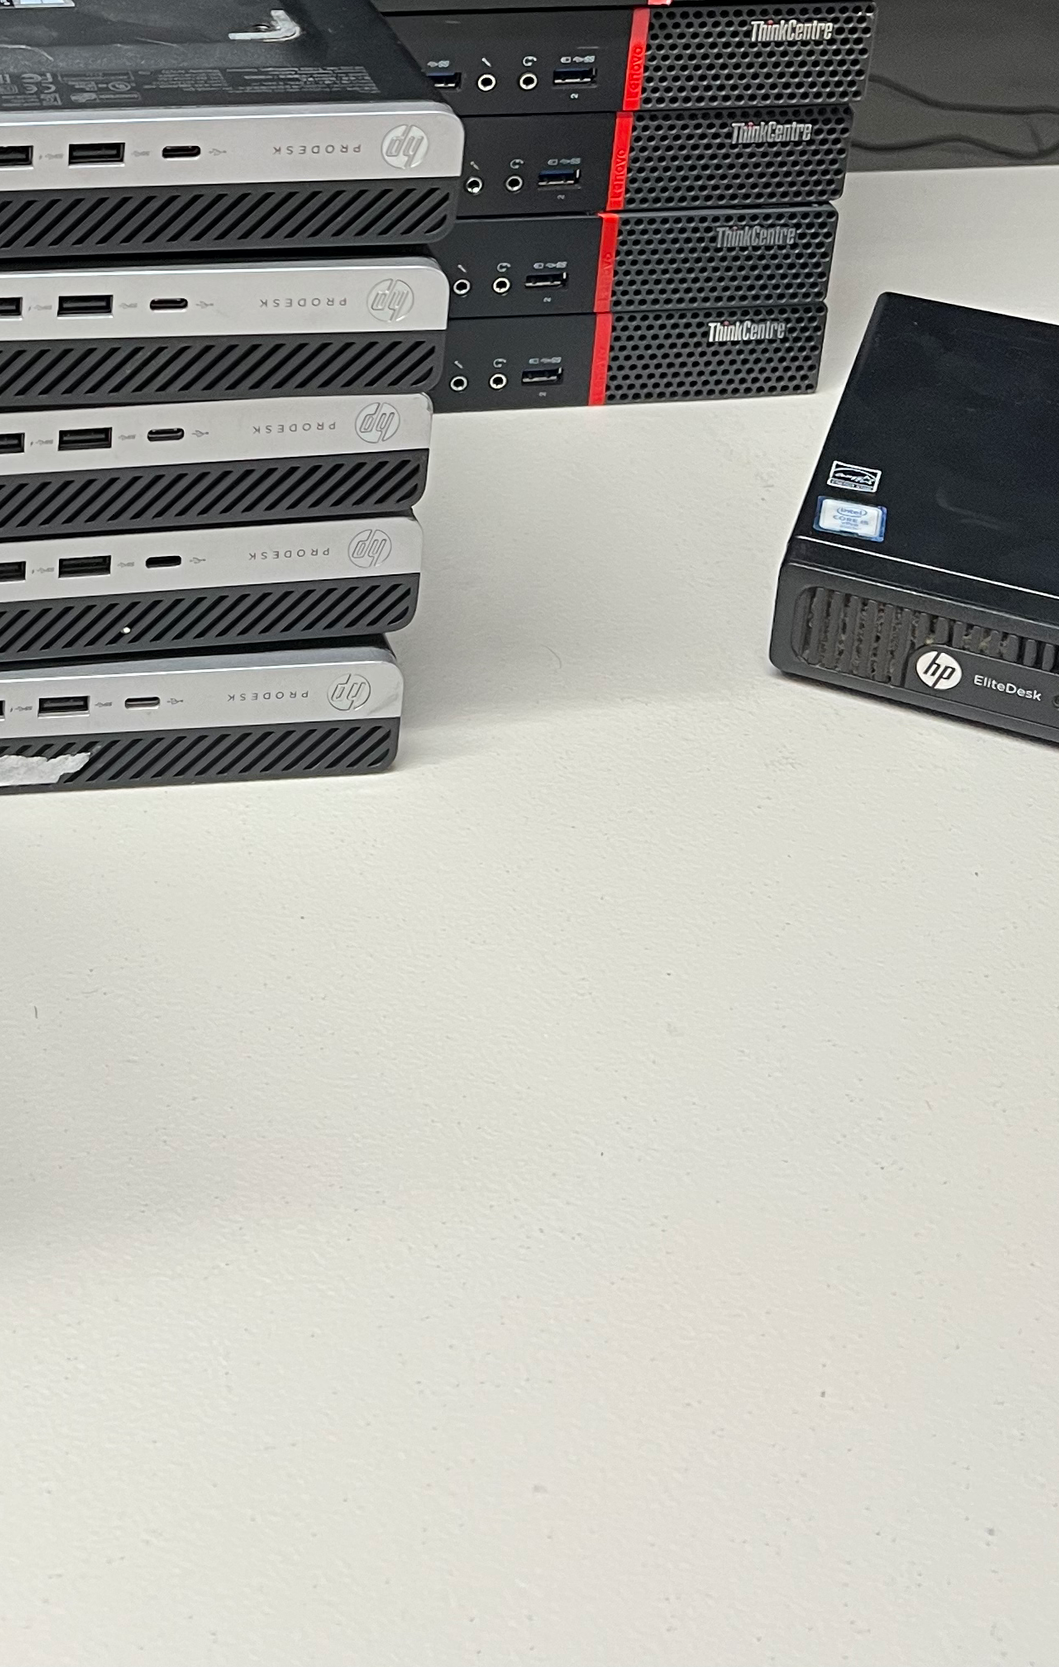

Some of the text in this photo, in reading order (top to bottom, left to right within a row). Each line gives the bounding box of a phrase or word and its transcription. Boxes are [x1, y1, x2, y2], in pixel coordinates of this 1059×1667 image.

[751, 19, 833, 42] ThinkCentre
[731, 122, 812, 144] ThinkCentre
[273, 144, 361, 155] PRODESK
[716, 225, 796, 248] ThinkCentre
[259, 298, 347, 308] PRODESK
[708, 320, 785, 343] ThinkCentre
[252, 422, 336, 434] PRODESK
[248, 547, 330, 560] PRODESK
[920, 651, 958, 689] hp
[227, 691, 309, 701] PRODESK
[973, 674, 1042, 701] EliteDesk
